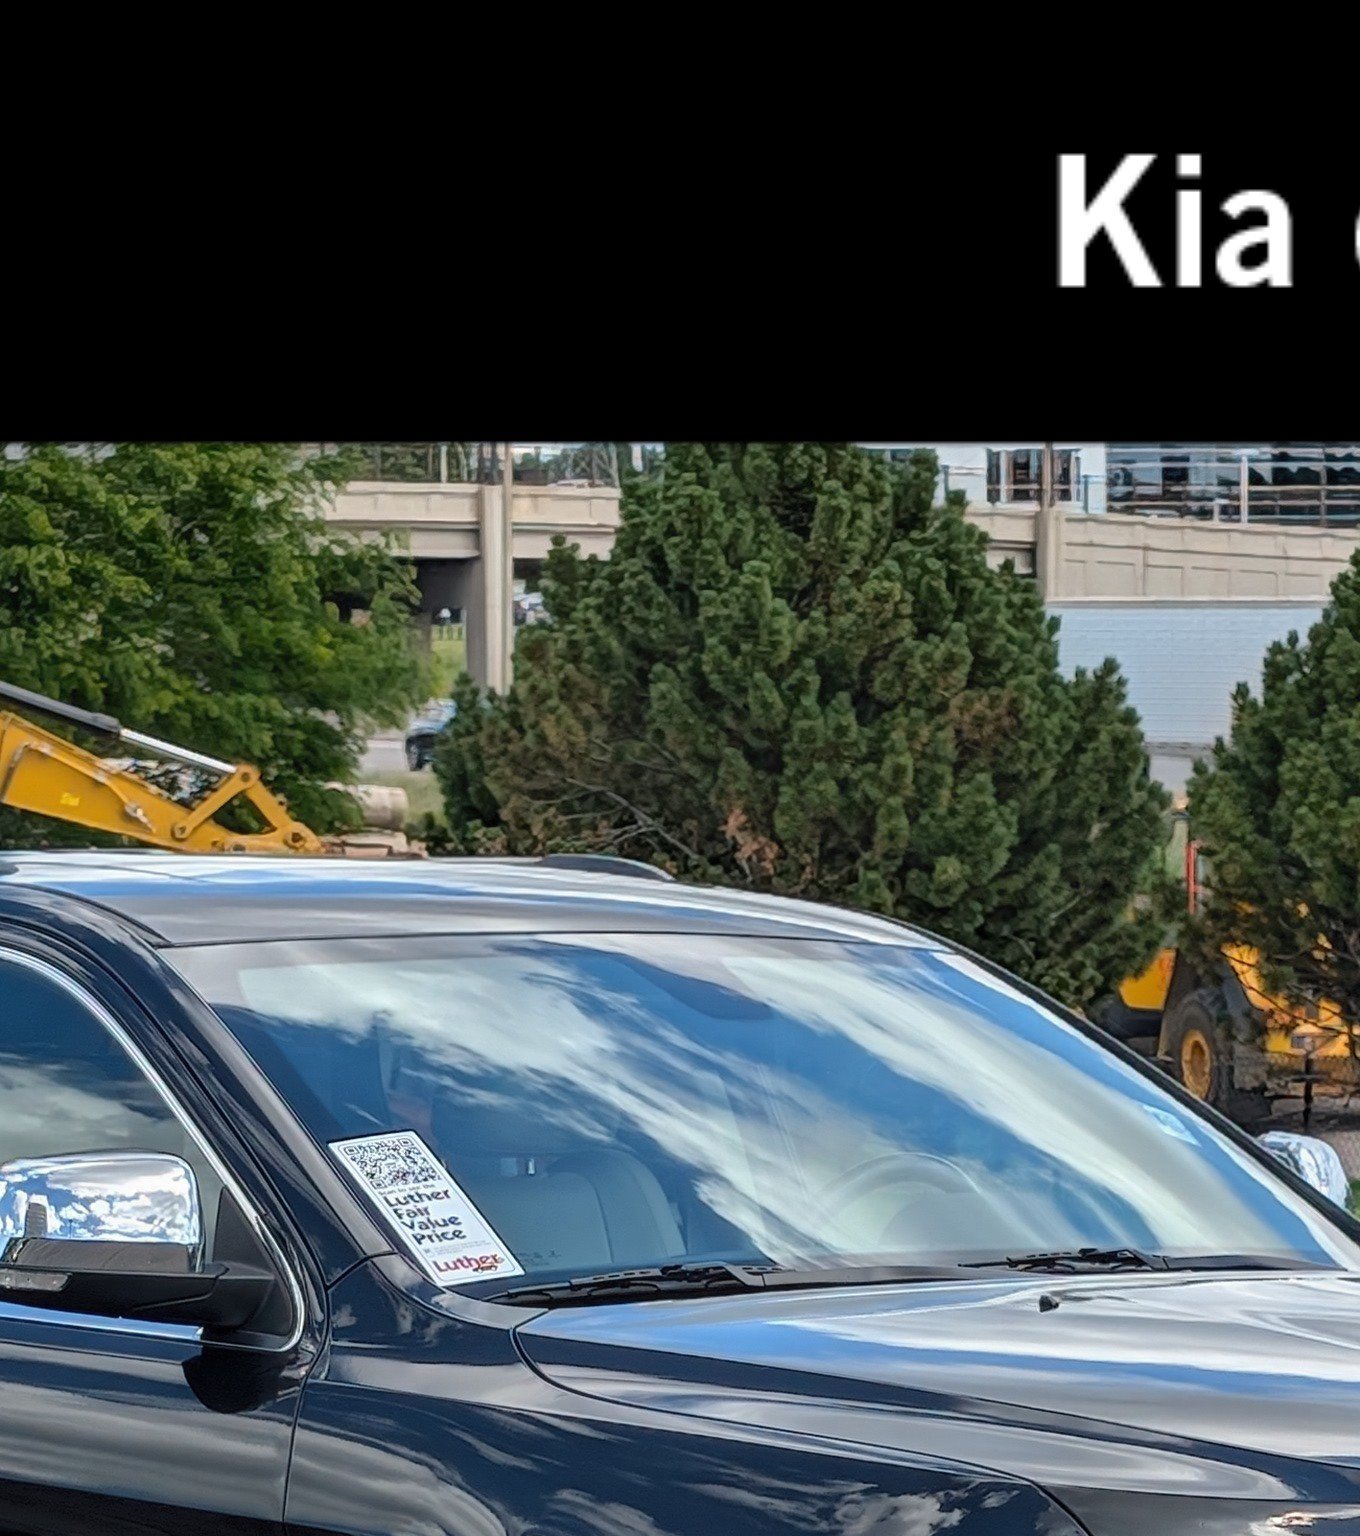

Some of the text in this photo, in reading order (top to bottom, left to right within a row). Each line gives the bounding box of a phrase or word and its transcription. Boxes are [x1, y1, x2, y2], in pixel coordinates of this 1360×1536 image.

[383, 1189, 451, 1207] Luther
[393, 1204, 431, 1219] Fair
[401, 1215, 462, 1231] Value
[412, 1228, 467, 1245] Price
[432, 1253, 500, 1273] Luther
